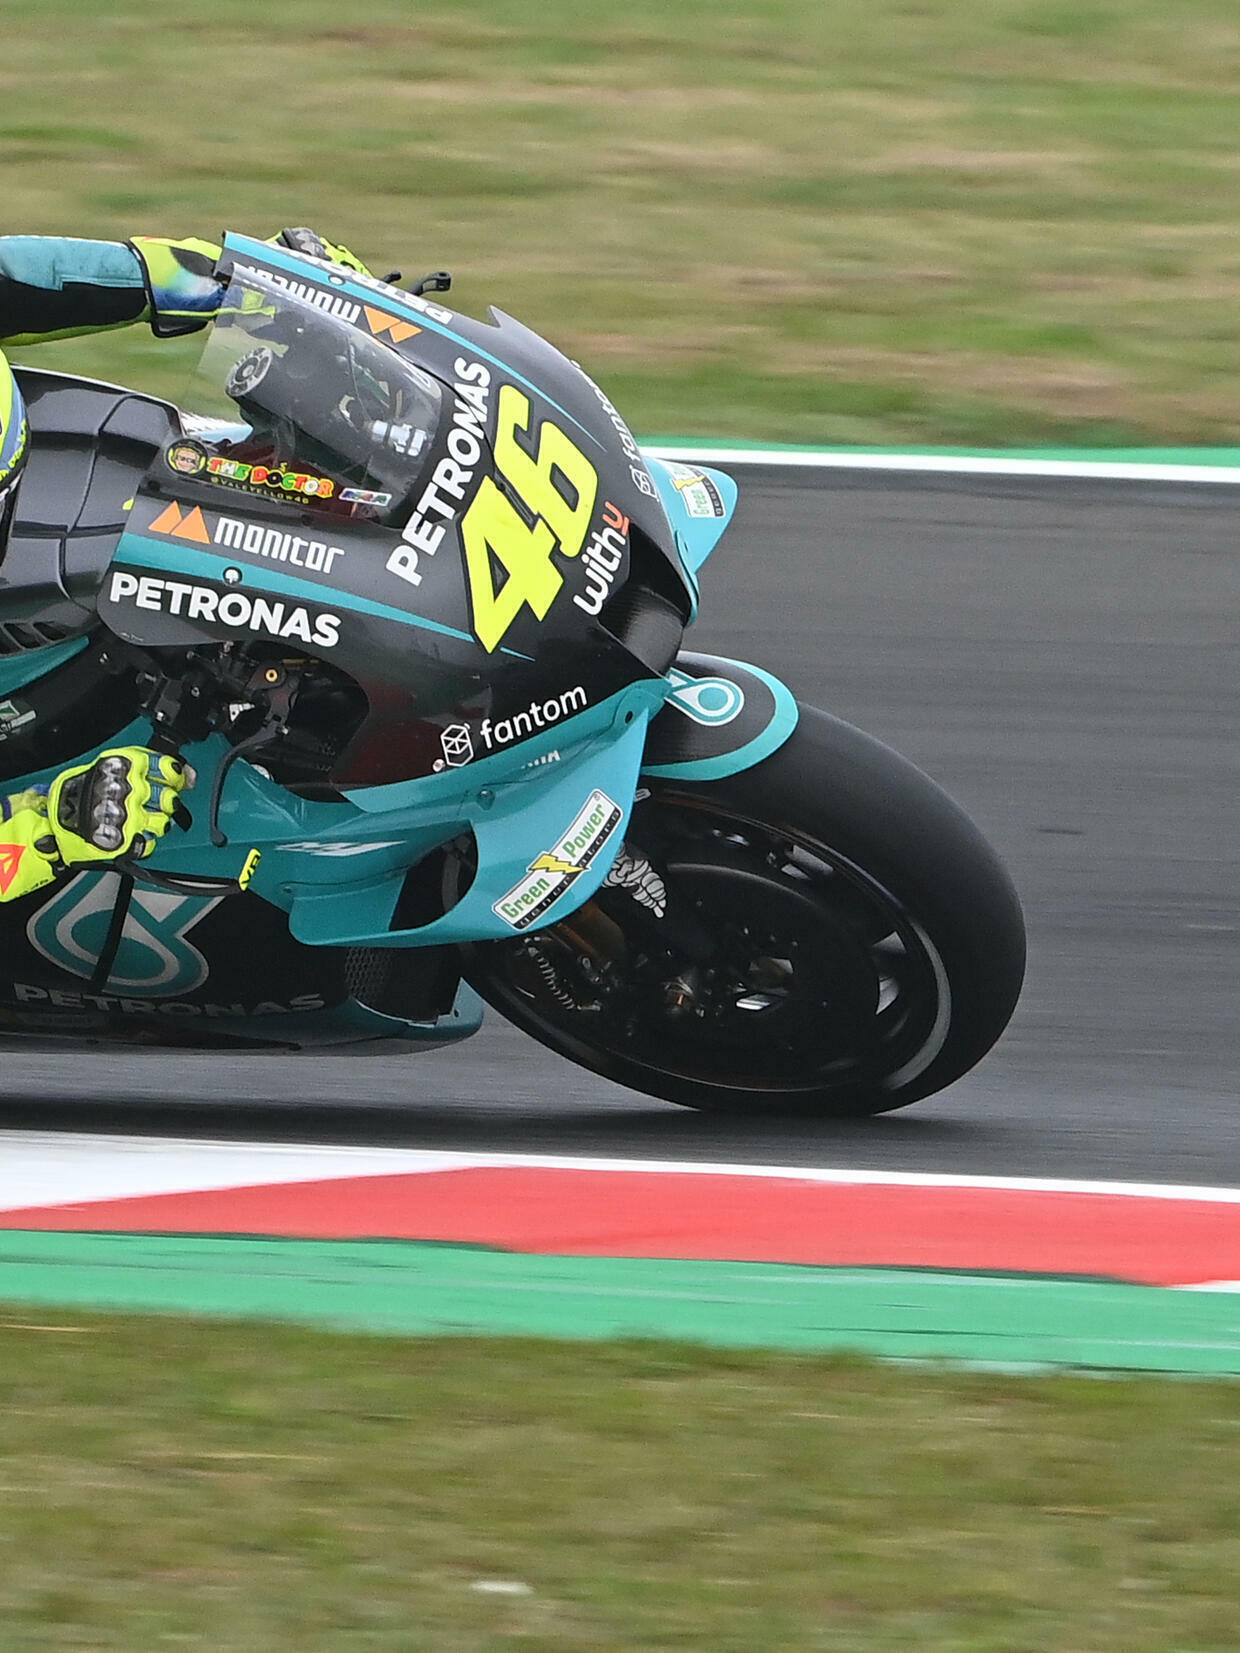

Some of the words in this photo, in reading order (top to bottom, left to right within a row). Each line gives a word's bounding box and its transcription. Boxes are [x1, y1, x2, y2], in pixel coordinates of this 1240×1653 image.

[571, 359, 641, 462] fanto
[208, 458, 251, 480] THE
[251, 466, 334, 498] DOCTOR
[385, 357, 491, 587] PETRONAS
[461, 384, 598, 655] 46
[110, 571, 342, 648] PETRONAS
[480, 685, 588, 750] fantom
[500, 877, 551, 918] Green
[562, 804, 606, 858] Power
[14, 983, 325, 1017] PETRONAS
